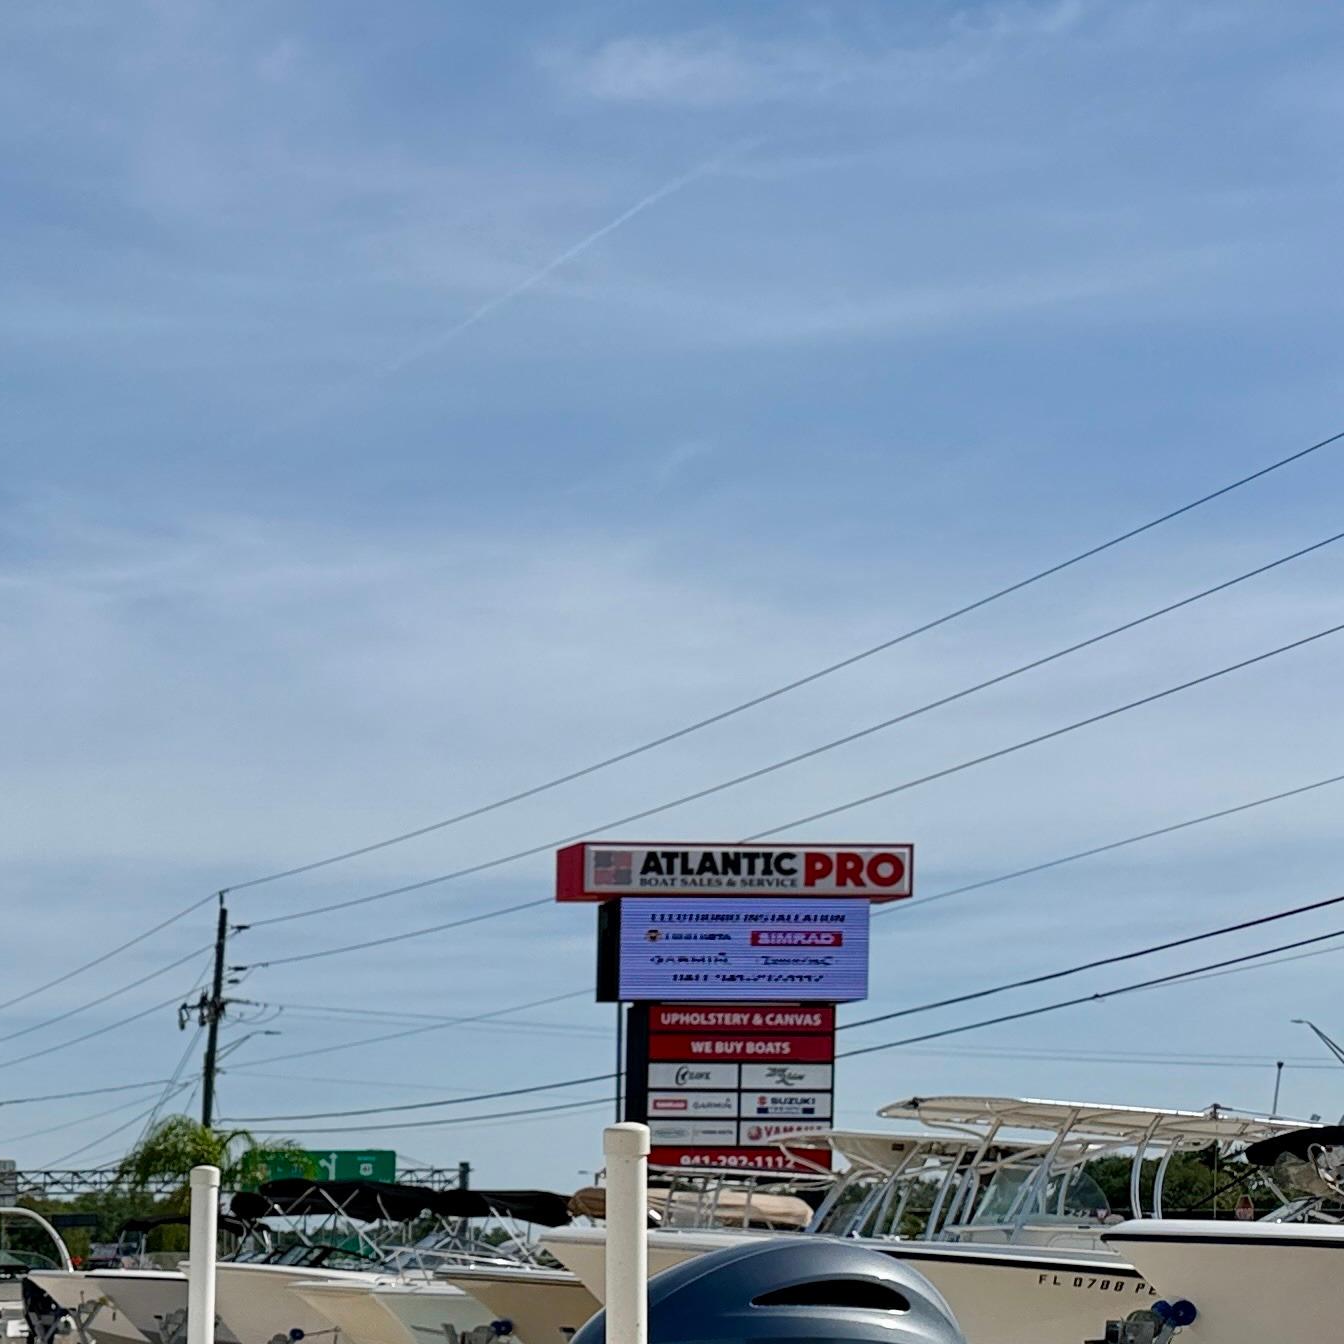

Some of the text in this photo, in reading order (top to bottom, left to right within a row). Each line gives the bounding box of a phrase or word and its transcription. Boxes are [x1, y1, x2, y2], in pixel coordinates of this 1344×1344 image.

[640, 851, 905, 888] ATLANTIC PRO
[640, 878, 798, 888] BOAT SALES & SERVICE
[757, 932, 836, 945] SIMRAD
[661, 1013, 822, 1026] UPHOLSTERY & CANVAS
[691, 1041, 791, 1054] WE BUY BOATS
[770, 1096, 816, 1105] SUZUKI
[1039, 1274, 1061, 1286] FL
